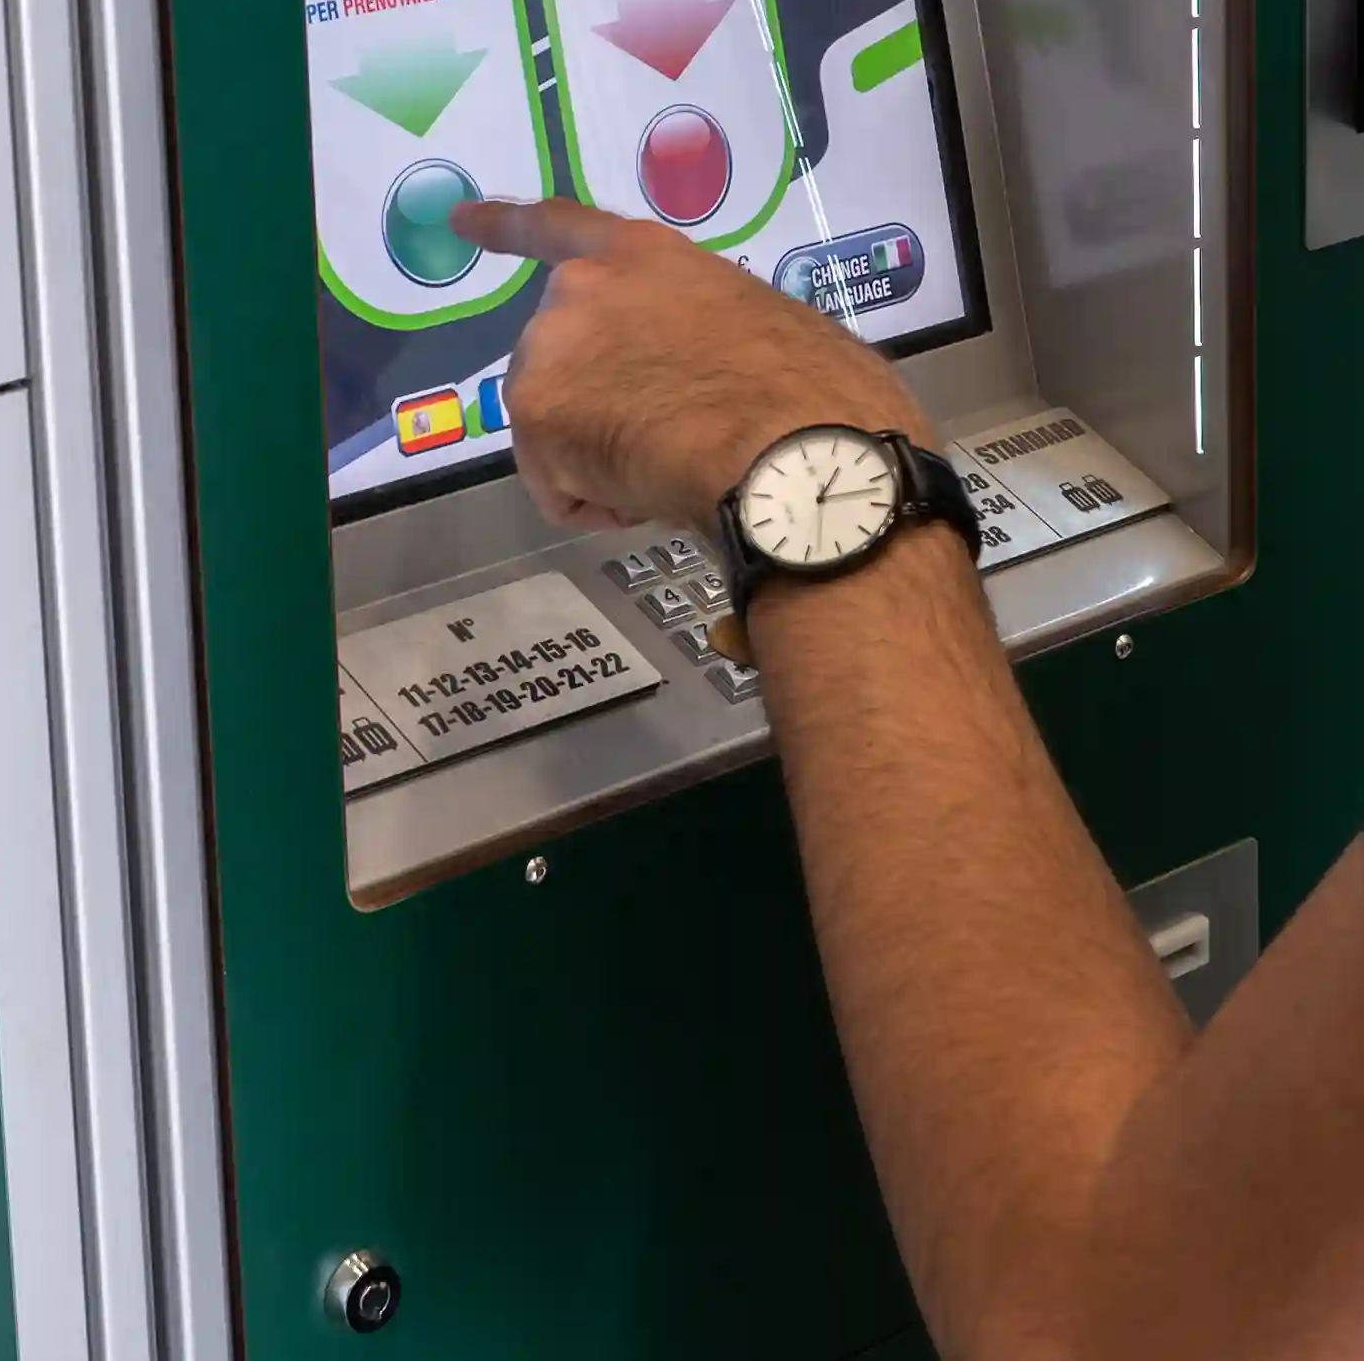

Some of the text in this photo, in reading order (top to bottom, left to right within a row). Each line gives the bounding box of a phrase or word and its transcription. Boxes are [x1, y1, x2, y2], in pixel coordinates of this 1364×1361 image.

[306, 0, 340, 25] PER
[811, 255, 870, 288] CHANGE
[815, 276, 893, 313] LANGUAGE
[974, 418, 1086, 465] STANDARD
[671, 538, 690, 554] 2
[980, 525, 1012, 548] 38
[629, 554, 644, 567] 1
[705, 573, 723, 588] 5
[664, 588, 680, 603] 4
[398, 628, 601, 708] 11-12-13-14-15-16
[418, 652, 630, 737] 17-18-19-20-21-22
